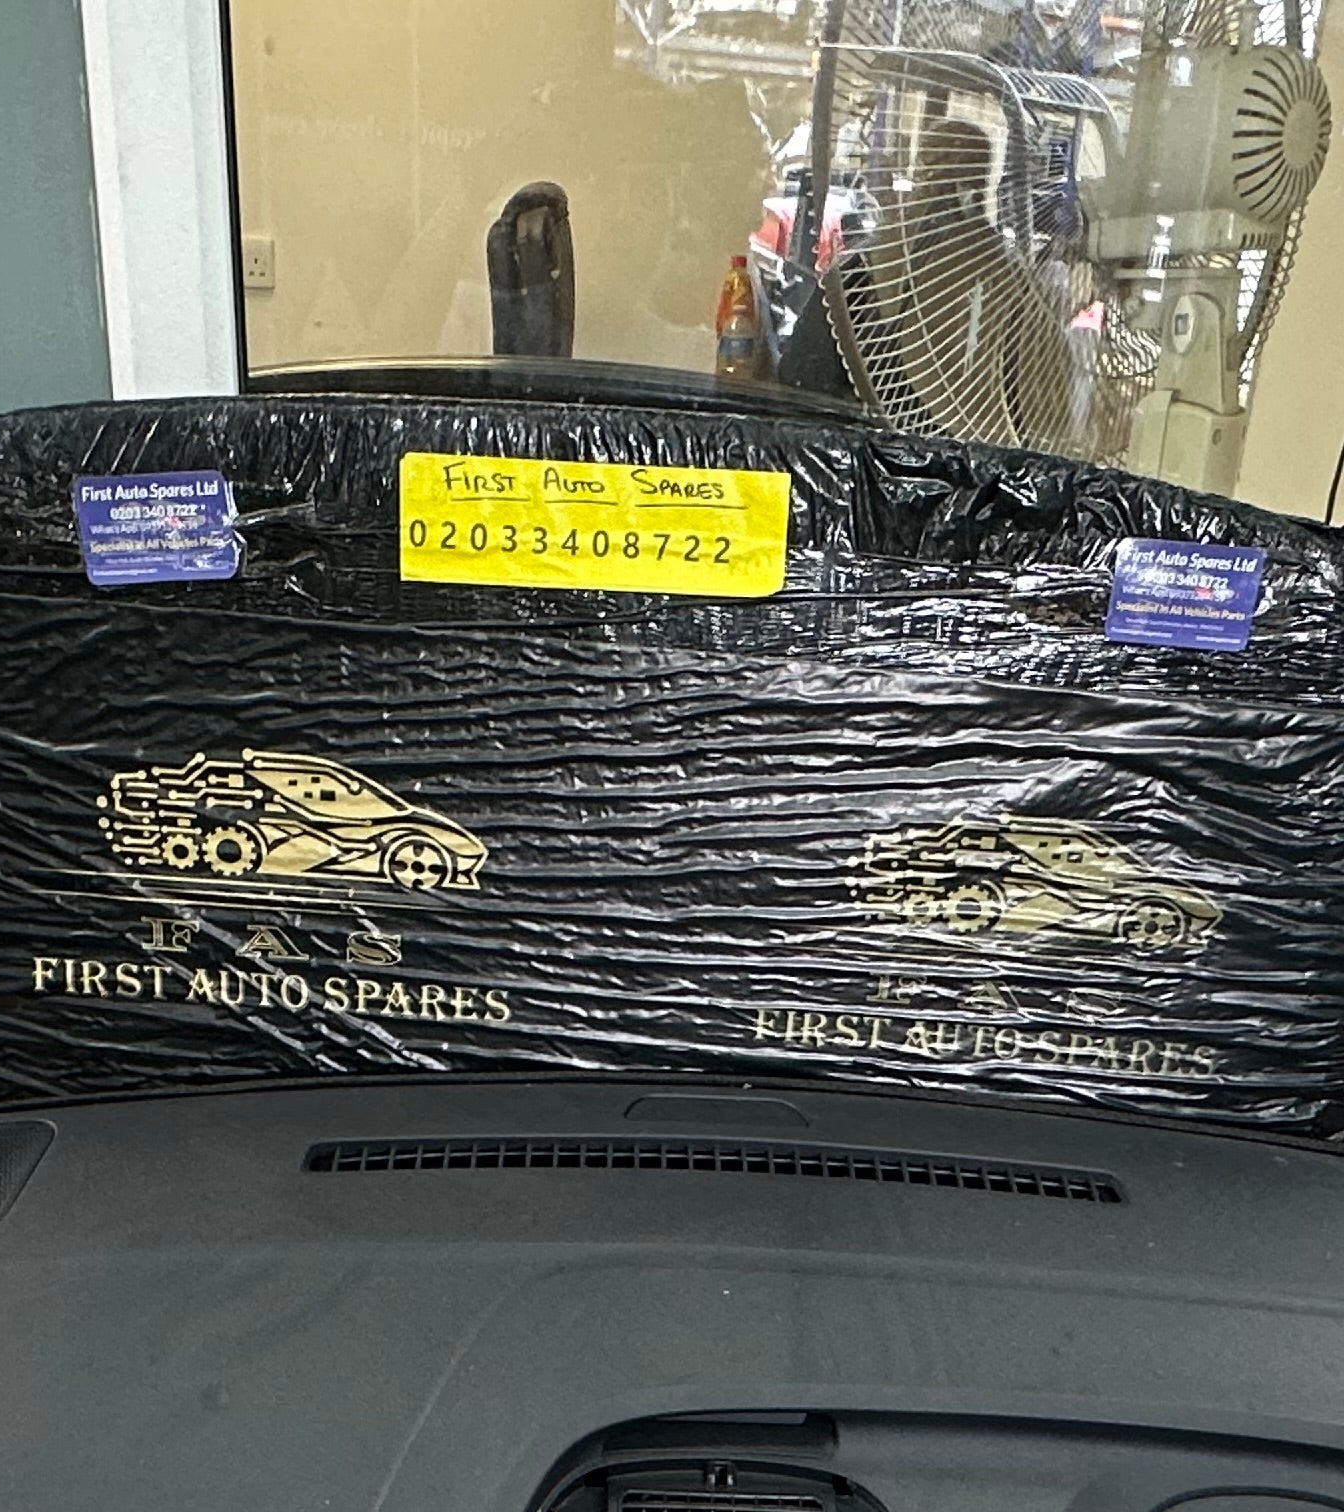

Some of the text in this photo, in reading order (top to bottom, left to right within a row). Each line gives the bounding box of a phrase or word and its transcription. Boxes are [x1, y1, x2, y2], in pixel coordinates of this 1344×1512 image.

[81, 480, 219, 502] First Auto Spares Ltd
[141, 506, 165, 518] 340
[409, 521, 731, 565] 02033408722
[1121, 549, 1258, 572] First Auto Spares Ltd
[1176, 575, 1197, 587] 340
[32, 956, 511, 1022] FIRST AUTO SPARES
[754, 1008, 1220, 1077] FIRST AUTO SPARES
